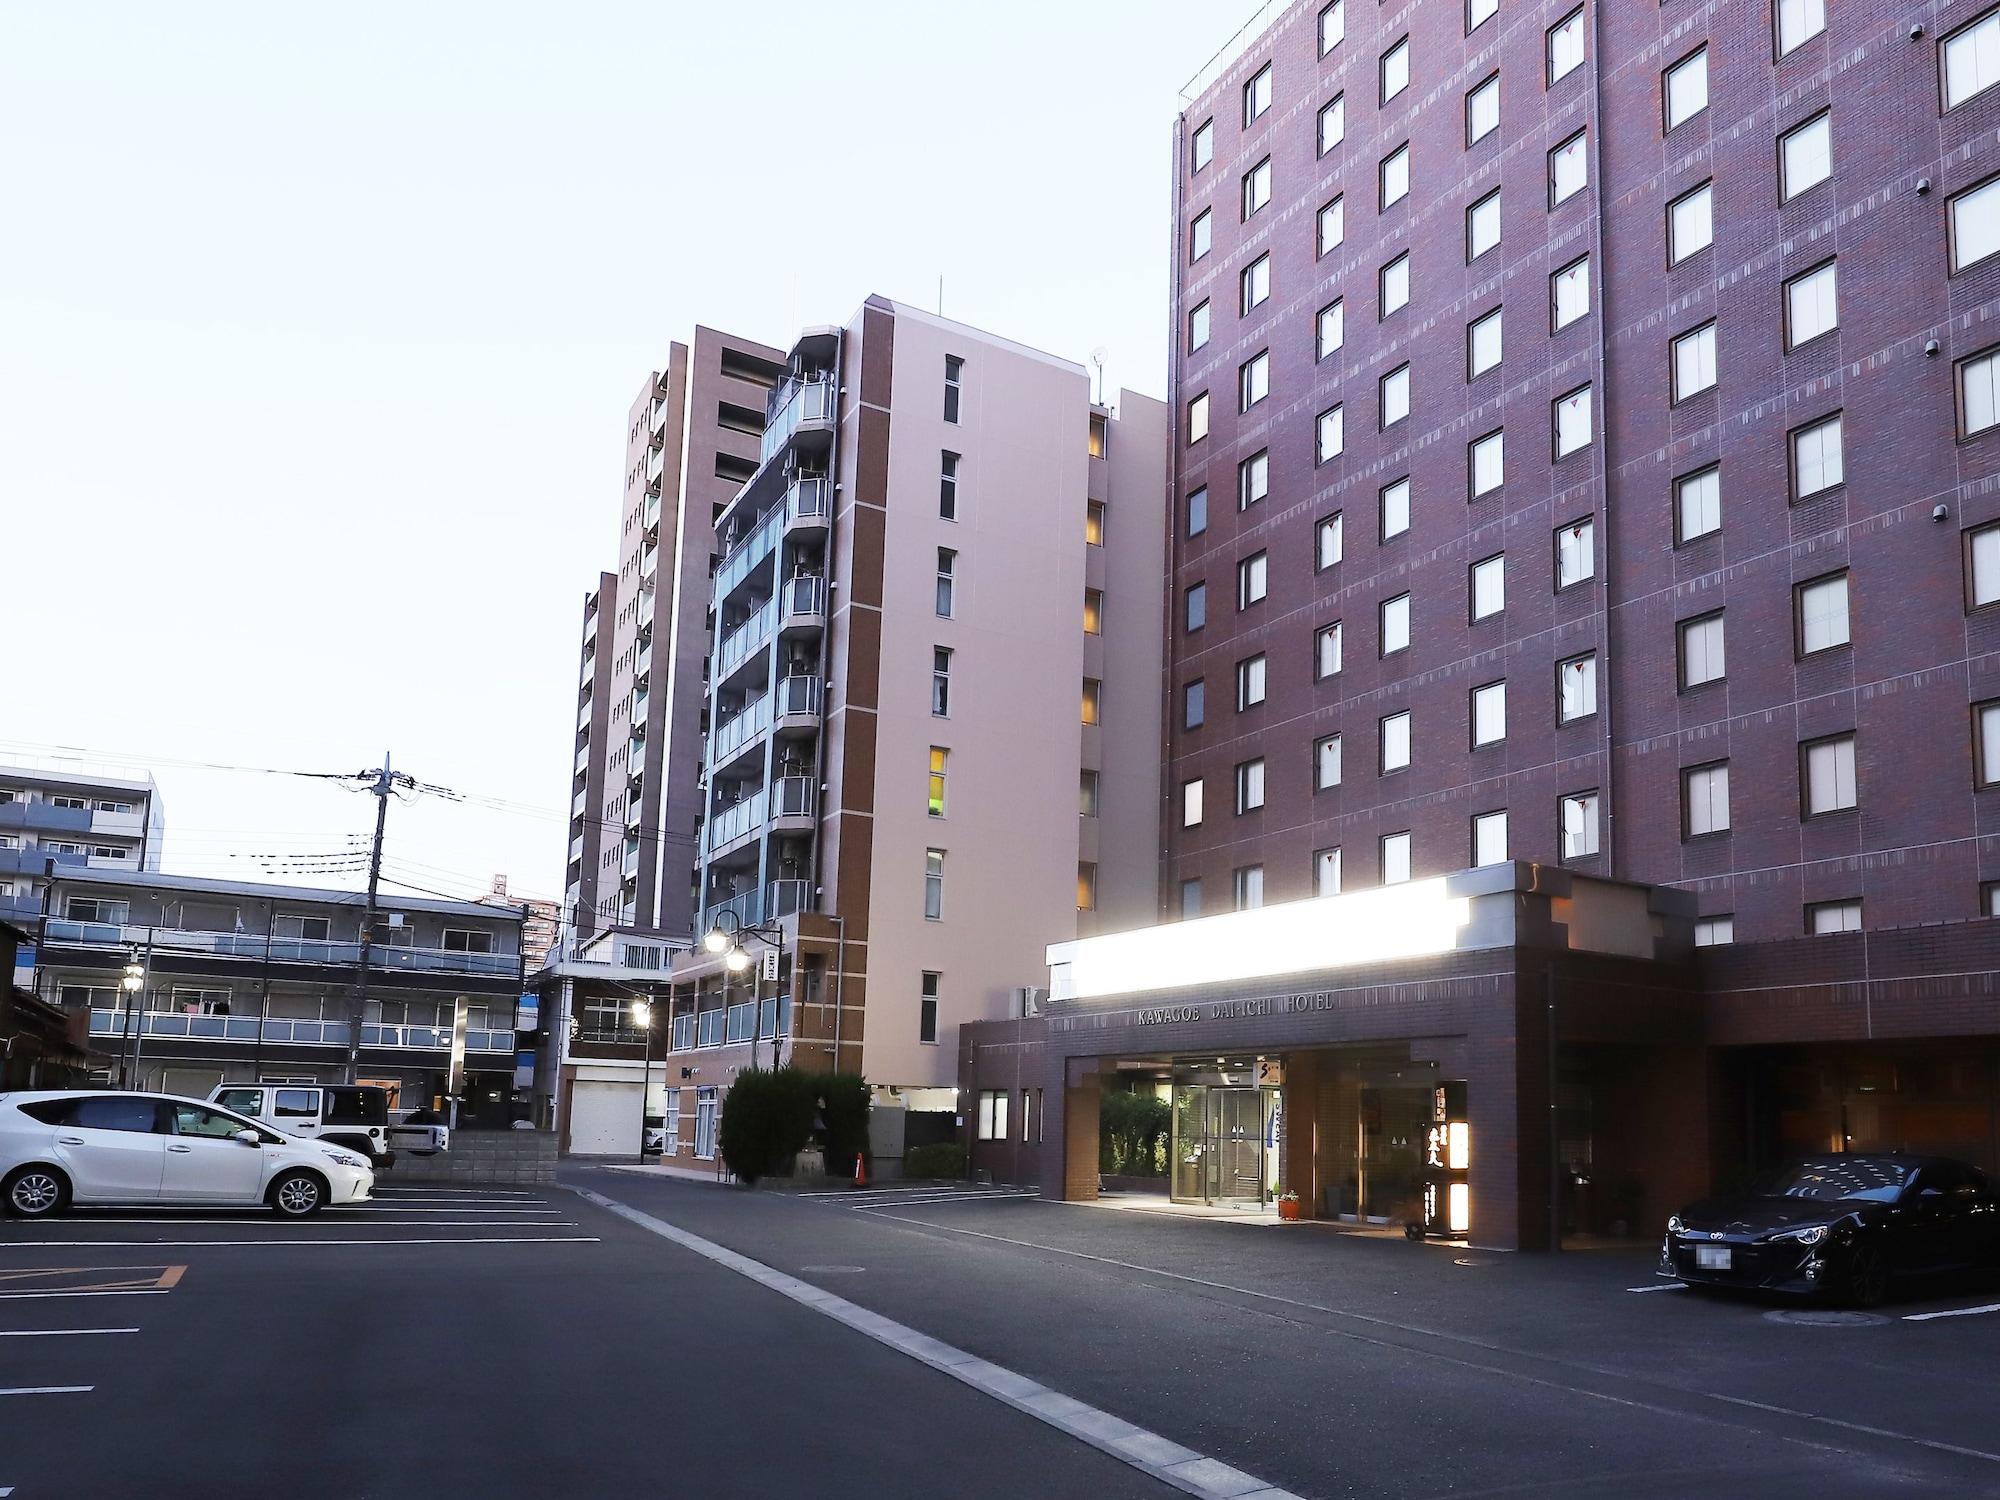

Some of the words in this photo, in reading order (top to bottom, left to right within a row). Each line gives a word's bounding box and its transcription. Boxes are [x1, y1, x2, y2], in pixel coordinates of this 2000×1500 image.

[1138, 1006, 1200, 1026] KAWAGOE
[1212, 998, 1273, 1019] DAI-ICHI
[1287, 993, 1334, 1013] HOTEL
